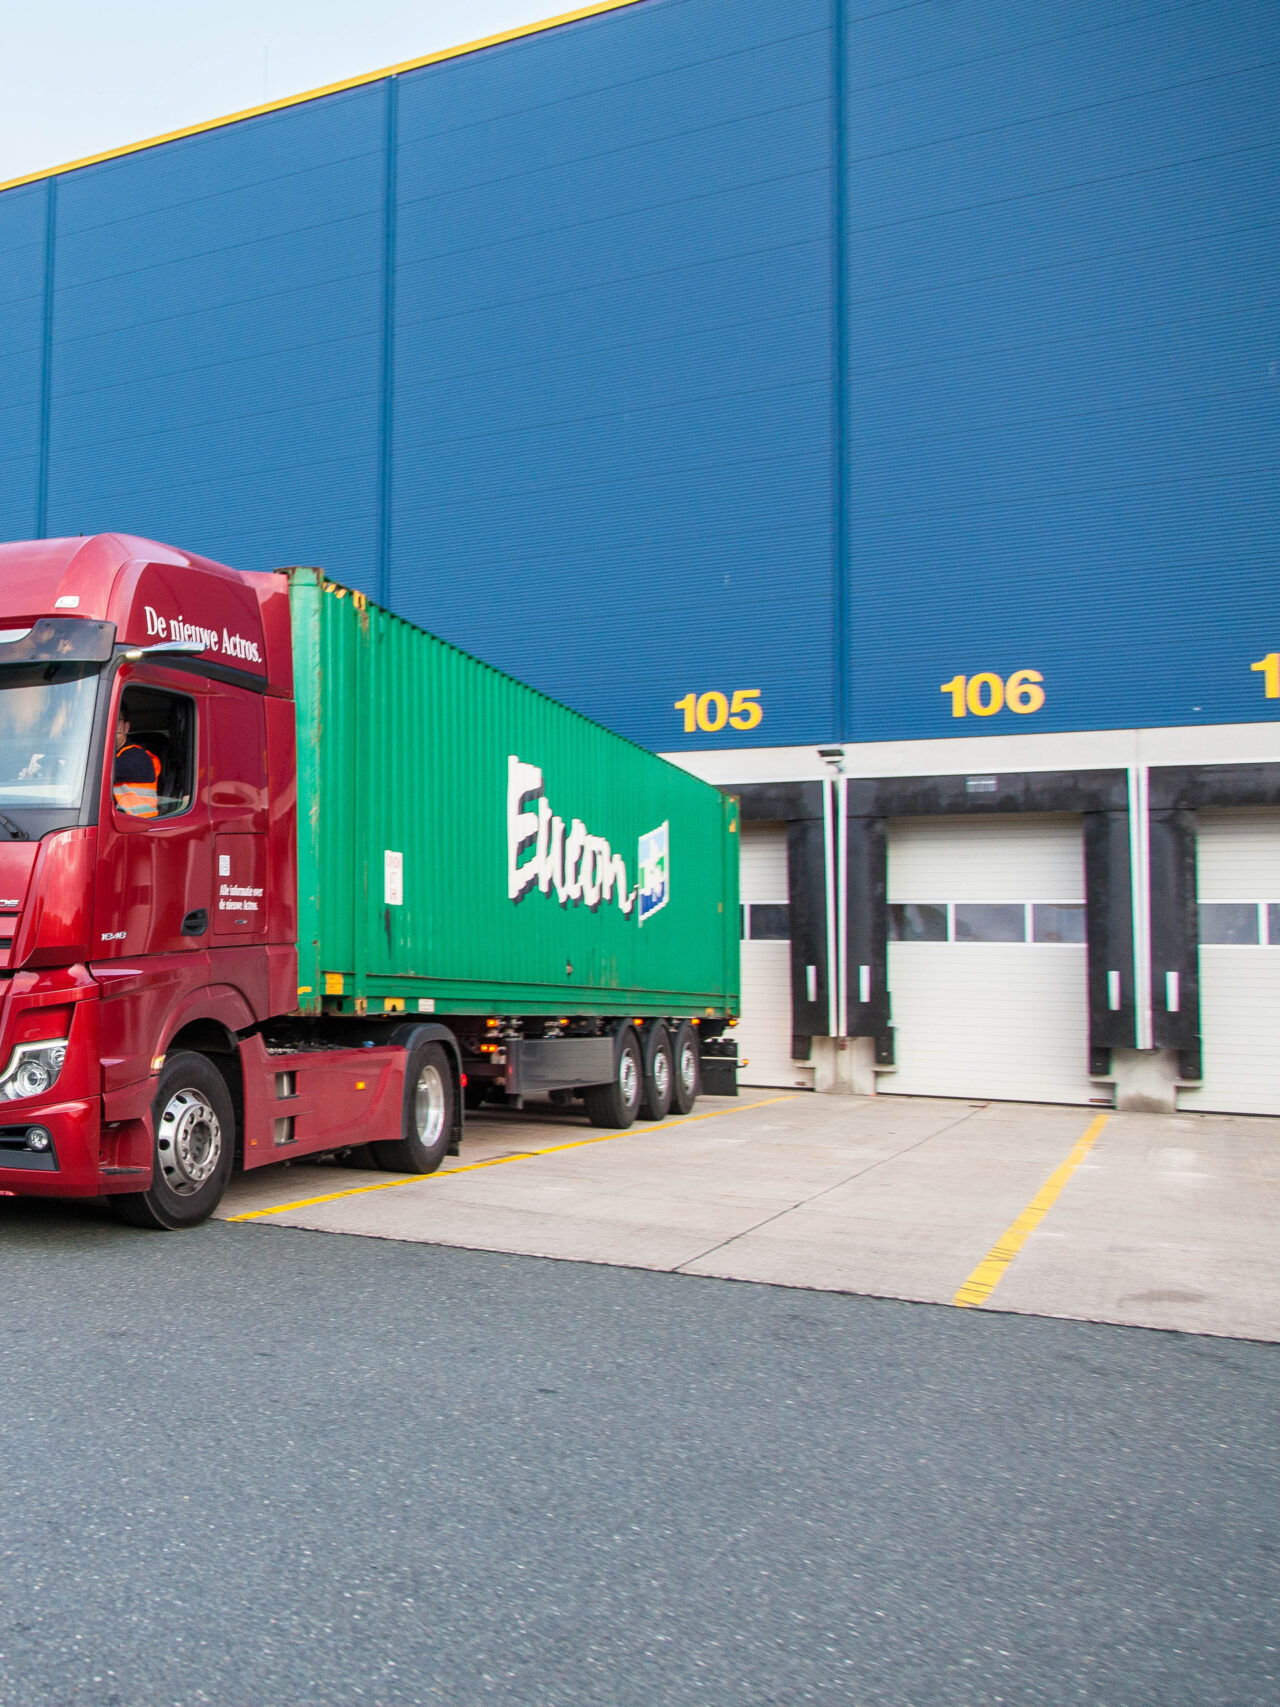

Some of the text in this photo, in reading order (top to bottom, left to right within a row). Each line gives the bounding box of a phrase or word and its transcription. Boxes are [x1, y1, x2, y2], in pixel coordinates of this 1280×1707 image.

[144, 605, 262, 663] De nieuwe Actros.
[674, 689, 763, 733] 105
[940, 669, 1046, 718] 106
